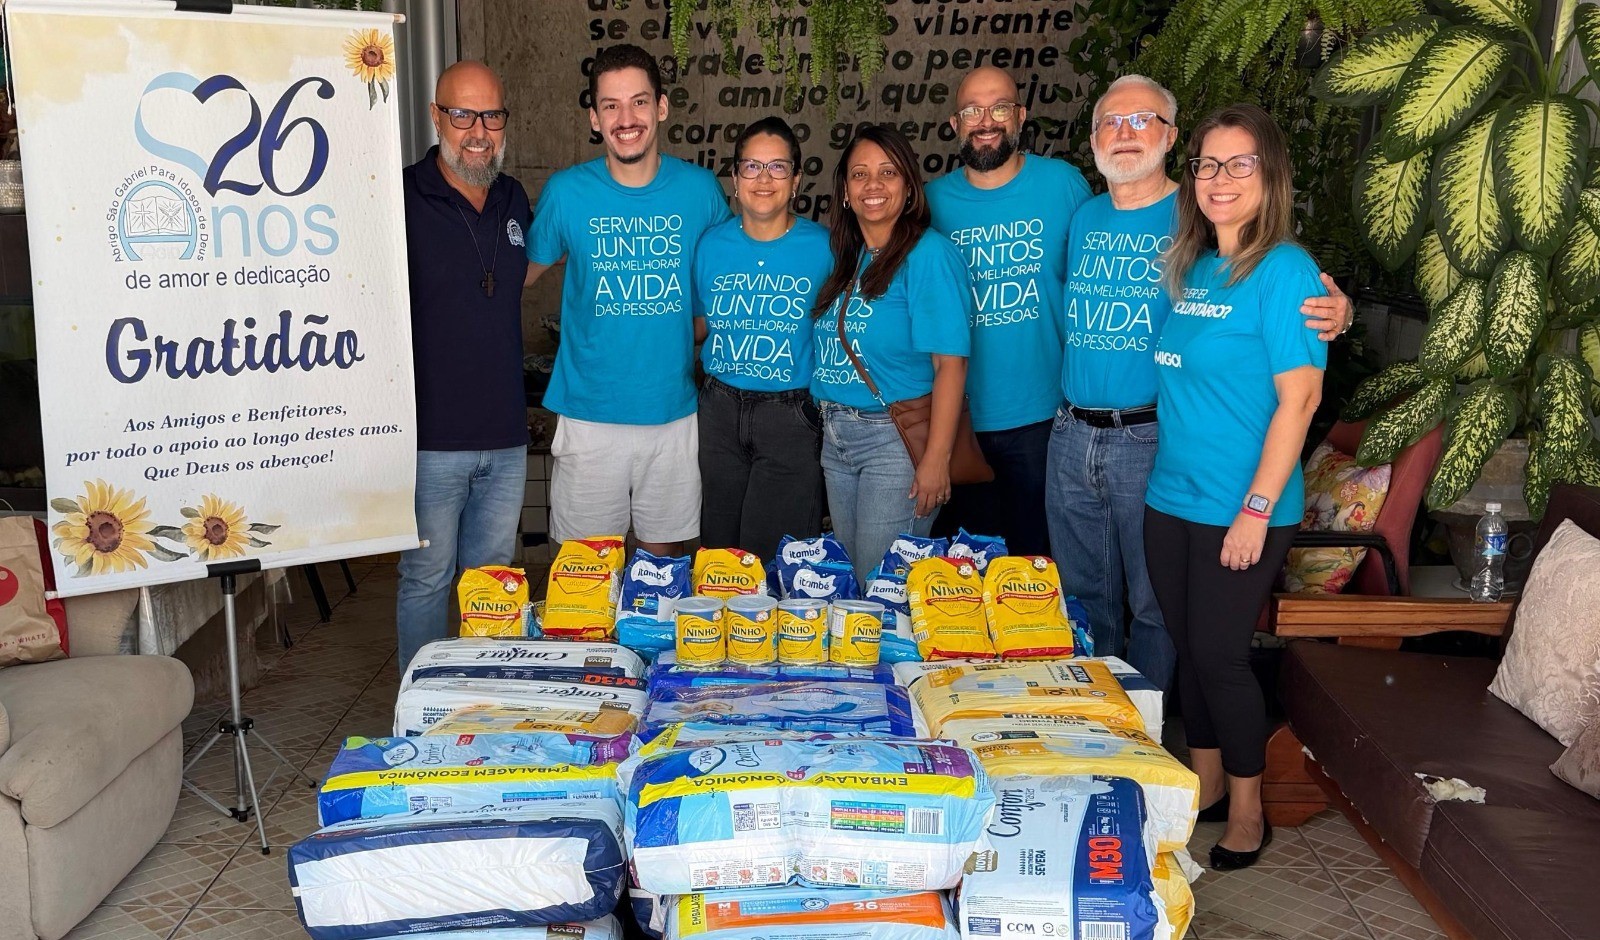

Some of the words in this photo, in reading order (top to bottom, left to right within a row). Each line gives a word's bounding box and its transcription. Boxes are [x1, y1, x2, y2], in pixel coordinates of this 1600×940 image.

[589, 18, 629, 41] se
[914, 5, 1074, 36] vibrante
[923, 46, 1059, 80] perene
[881, 82, 949, 112] que
[193, 74, 335, 198] 26
[668, 123, 811, 145] corao
[115, 166, 147, 197] Gabriel
[150, 165, 176, 181] Para
[177, 177, 202, 213] Idosos
[106, 200, 120, 221] São
[198, 215, 207, 230] de
[589, 214, 683, 235] SERVINDO
[950, 218, 1044, 247] SERVINDO
[108, 225, 124, 262] Abrigo
[197, 233, 209, 262] Deus
[591, 234, 683, 259] JUNTOS
[1082, 231, 1175, 255] SERVINDO
[592, 260, 620, 272] PARA
[620, 258, 681, 271] MELHORAR
[977, 262, 1042, 282] MELHORAR
[1073, 253, 1167, 283] JUNTOS
[125, 269, 152, 290] de
[158, 267, 210, 289] amor
[216, 271, 228, 287] e
[234, 264, 331, 289] dedicação
[595, 274, 615, 301] A
[616, 273, 683, 301] VIDA
[711, 273, 812, 295] SERVINDO
[971, 278, 1040, 312] VIDA
[1069, 281, 1092, 295] PARA
[1093, 284, 1160, 300] MELHORAR
[595, 302, 621, 317] DAS
[706, 294, 807, 320] JUNTOS
[1067, 297, 1078, 328] A
[1085, 299, 1153, 334] VIDA
[1173, 299, 1233, 320] OLUNTÁRIO?
[733, 319, 799, 335] MELHORAR
[105, 309, 365, 384] Gratidão
[711, 333, 725, 359] A
[727, 334, 794, 366] VIDA
[1154, 350, 1182, 369] MIGO!
[123, 417, 156, 434] Aos
[160, 410, 226, 433] Amigos
[231, 412, 241, 424] e
[247, 402, 348, 425] Benfeitores,
[65, 449, 101, 467] por
[106, 442, 148, 461] todo
[152, 444, 163, 457] o
[168, 436, 220, 456] apoio
[225, 434, 247, 448] ao
[252, 428, 300, 450] longo
[304, 422, 355, 442] destes
[359, 421, 403, 436] anos.
[144, 464, 180, 482] Que
[185, 459, 230, 477] Deus
[235, 458, 255, 472] os
[260, 449, 335, 471] abençoe!
[788, 547, 821, 559] itambé
[561, 563, 604, 573] NINHO
[637, 568, 668, 581] itambé
[706, 573, 750, 587] NINHO
[799, 577, 831, 591] itambé
[872, 584, 905, 596] itambé
[1001, 581, 1047, 593] NINHO
[930, 585, 974, 597] NINHO
[470, 601, 512, 614] NINHO
[18, 633, 46, 644] WHATS
[686, 627, 718, 638] NINHO
[731, 625, 761, 636] NINHO
[780, 624, 810, 634] NINHO
[583, 673, 640, 687] M30
[377, 768, 471, 781] ECONÔMICA
[473, 764, 570, 777] EMBALAGEM
[986, 787, 1047, 838] Confort
[1035, 849, 1046, 876] SEVERA
[1088, 836, 1124, 880] M30
[718, 901, 731, 909] M
[852, 900, 879, 912] 26
[558, 926, 583, 934] NOVA
[1006, 922, 1036, 935] CCM
